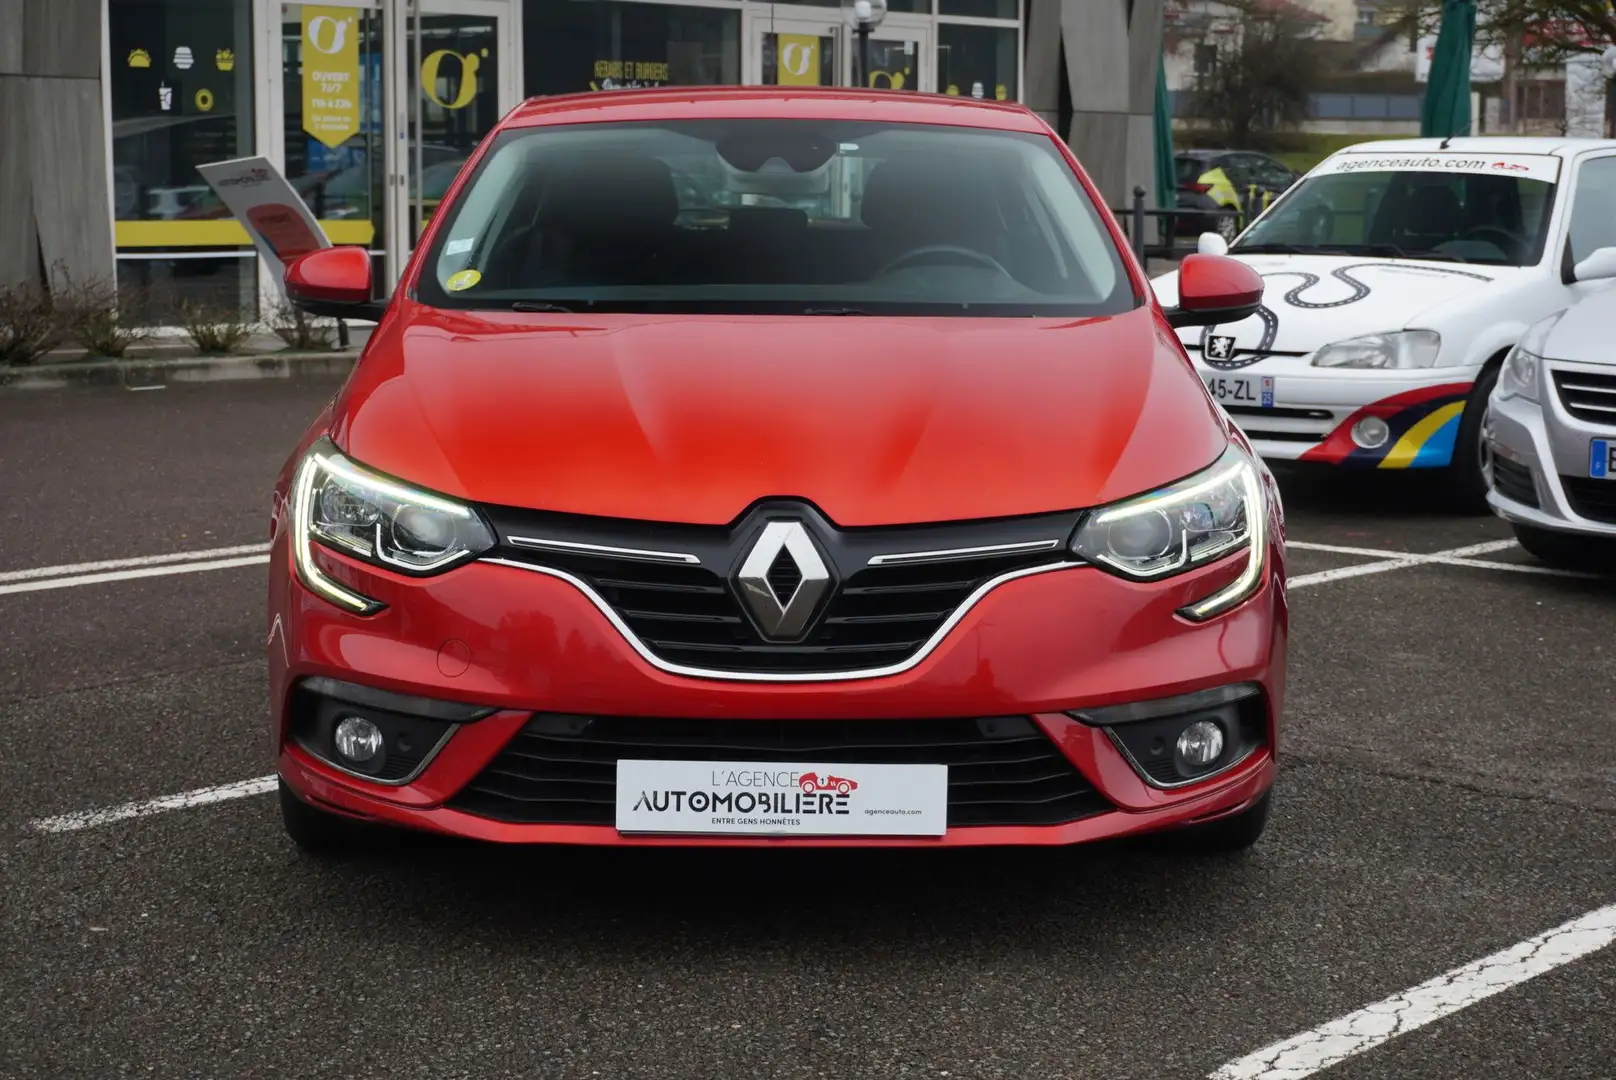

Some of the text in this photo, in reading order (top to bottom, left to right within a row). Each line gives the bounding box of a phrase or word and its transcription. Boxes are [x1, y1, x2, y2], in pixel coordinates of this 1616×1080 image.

[1336, 156, 1486, 172] agenceauto.com
[712, 770, 800, 788] L'AGENCE
[711, 816, 800, 826] ENTRE GENS HONNÊTES
